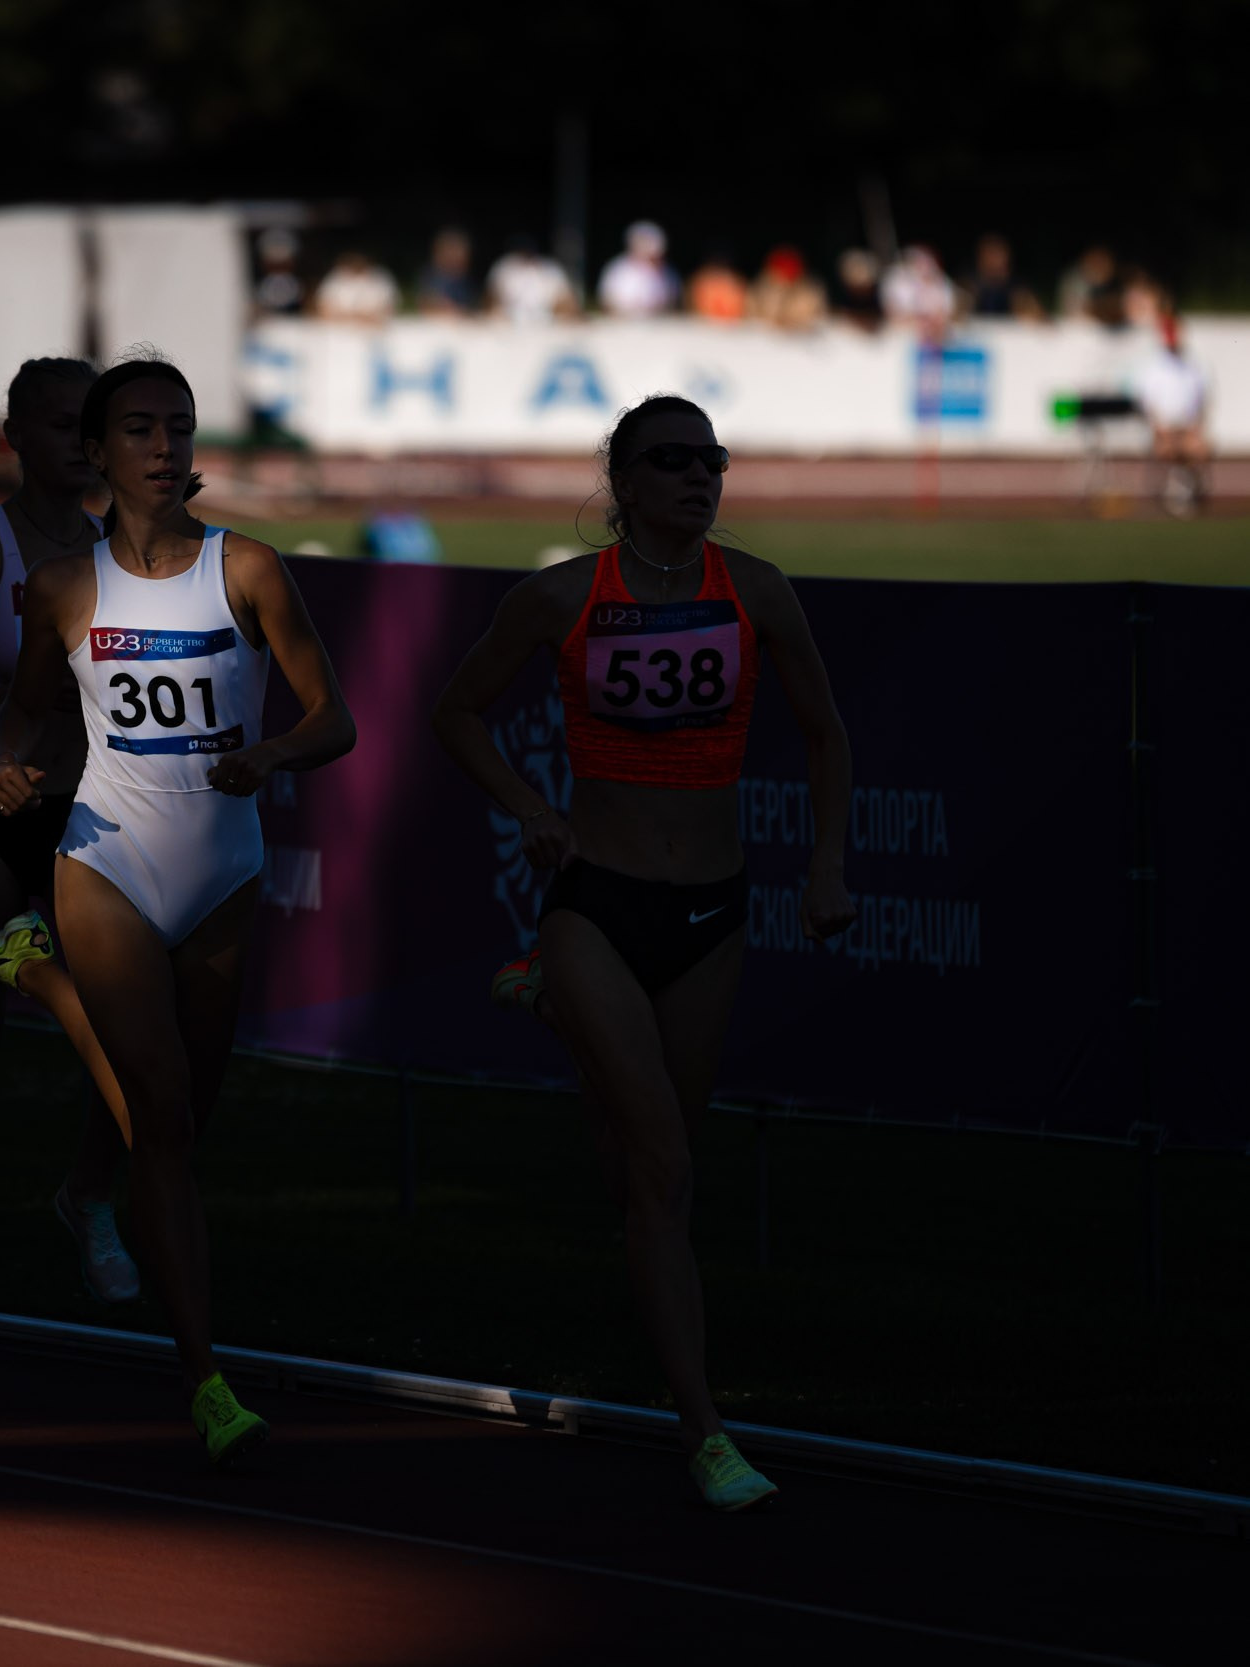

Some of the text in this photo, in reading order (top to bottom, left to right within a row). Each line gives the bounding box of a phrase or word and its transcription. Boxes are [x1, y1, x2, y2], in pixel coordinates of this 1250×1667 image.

[595, 608, 642, 626] U23
[95, 632, 141, 651] U23
[143, 637, 206, 647] ПЕРВЕНСТВО
[143, 644, 183, 653] РОССИИ
[602, 648, 725, 707] 538
[109, 672, 217, 728] 301
[200, 741, 219, 749] ПСБ
[851, 786, 949, 857] СПОРТА
[824, 893, 981, 977] ЕДЕРАЦИИ
